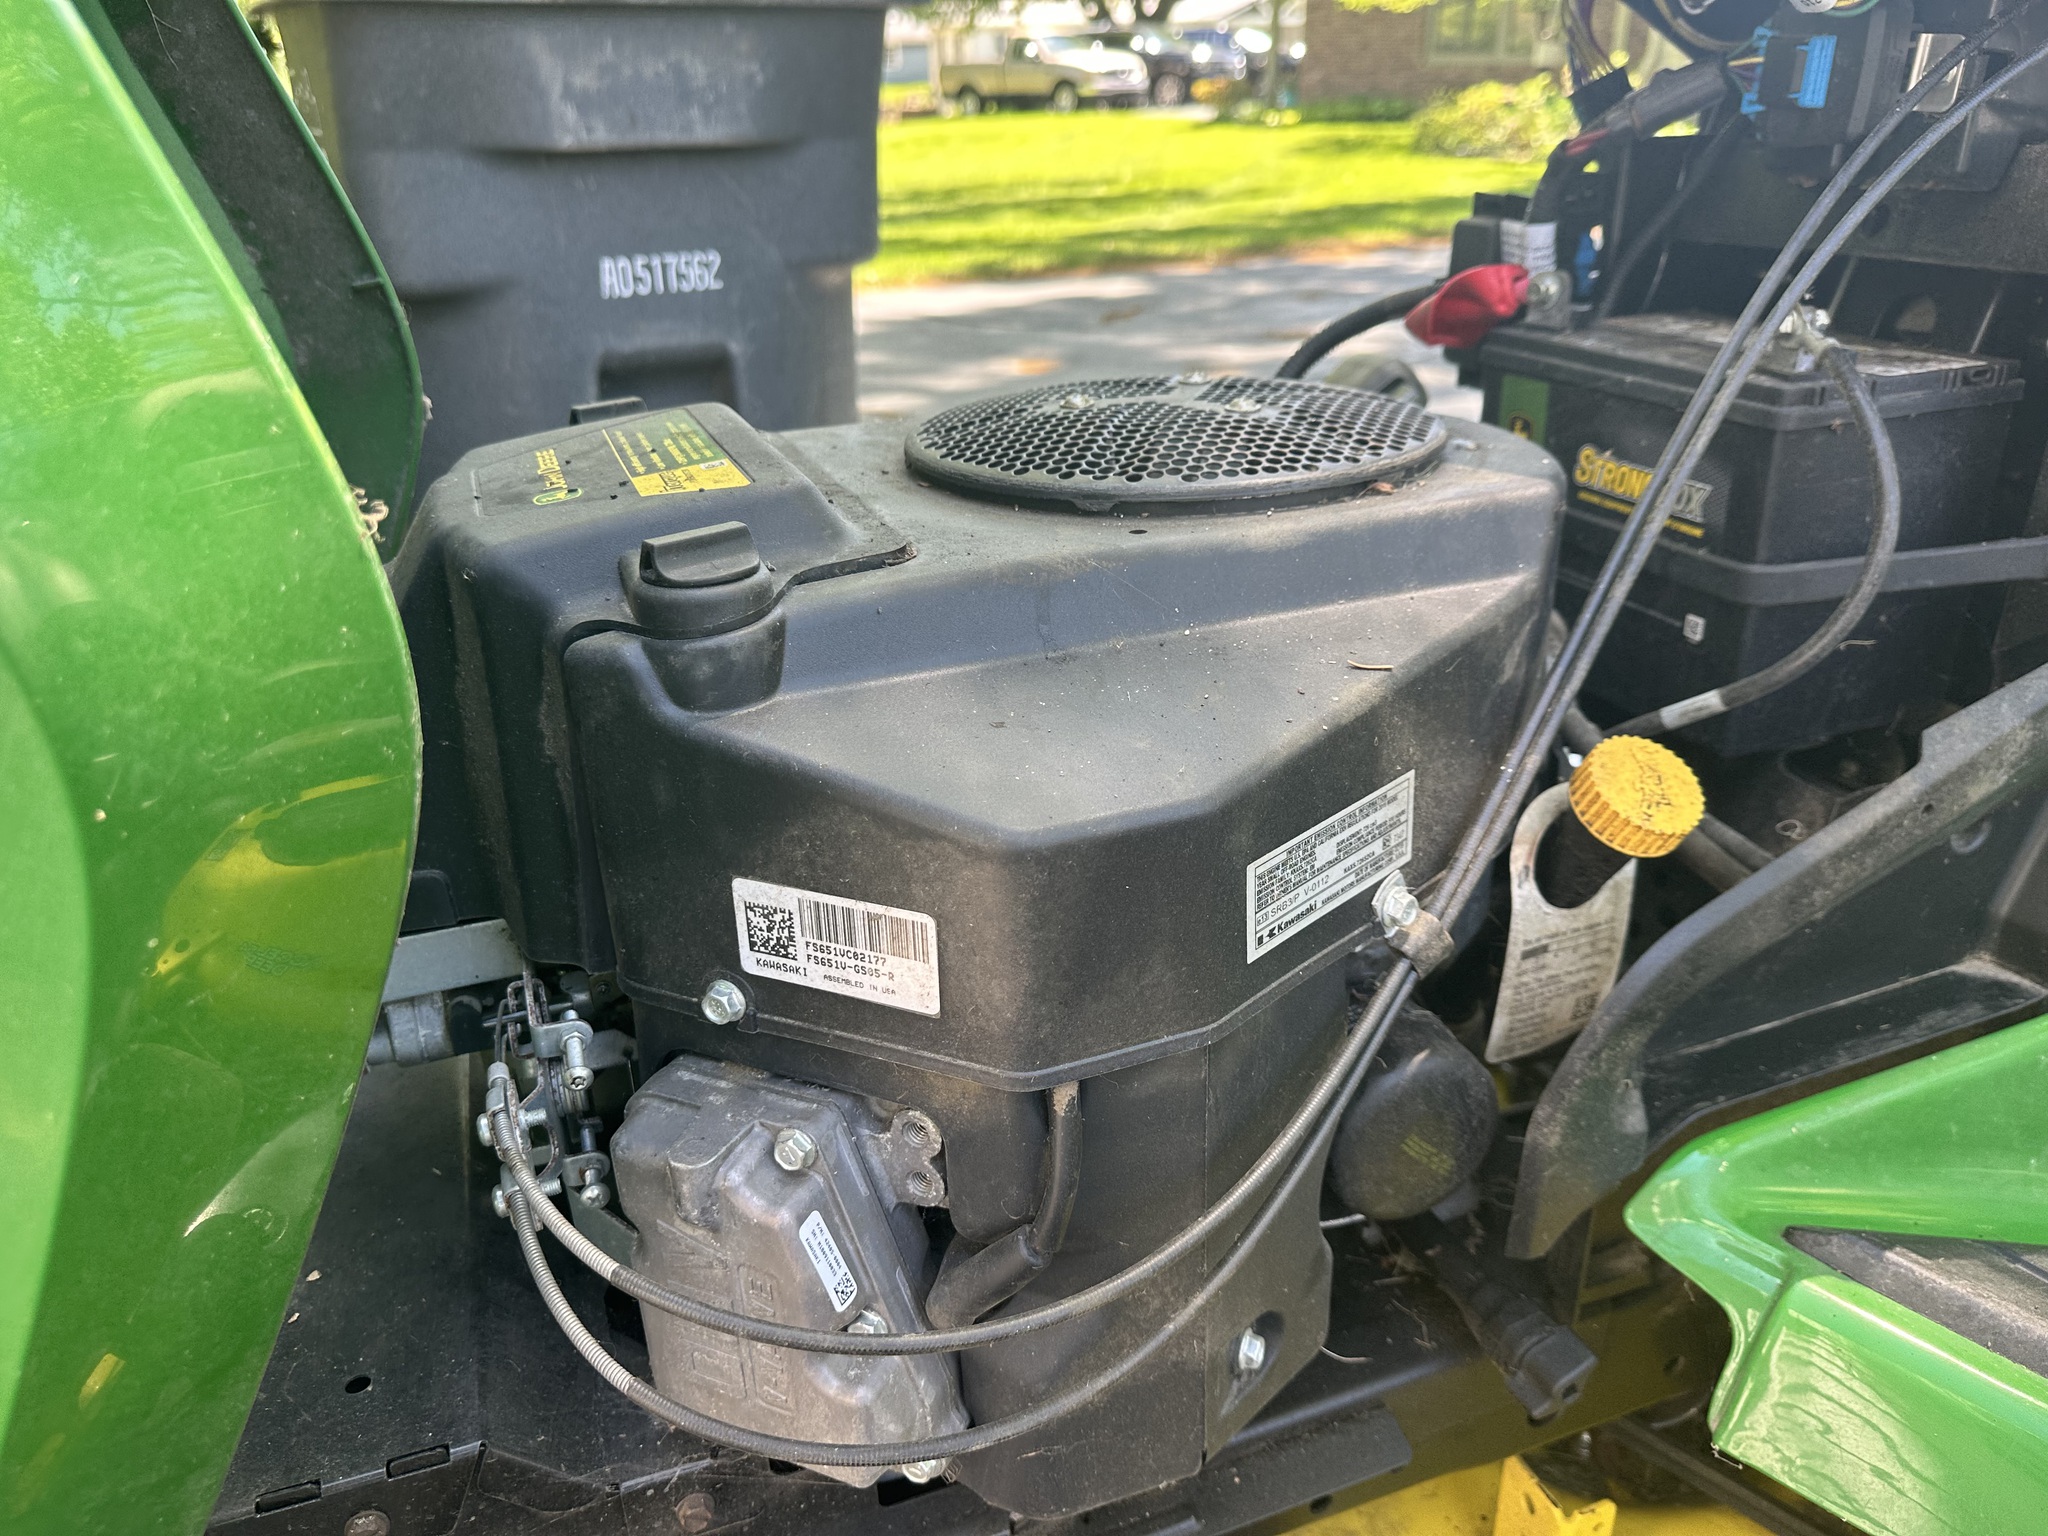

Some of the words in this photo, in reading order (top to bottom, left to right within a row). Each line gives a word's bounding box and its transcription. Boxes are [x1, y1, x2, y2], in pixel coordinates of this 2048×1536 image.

[1304, 874, 1328, 897] V-0112
[1277, 899, 1316, 934] Kawasaki
[805, 941, 887, 966] FS651VC02177
[756, 957, 808, 977] KAWASAKI
[806, 955, 895, 981] FS651V-GS05-R
[823, 974, 865, 989] ASSEMBLED
[869, 984, 878, 993] IN
[805, 1237, 821, 1265] KAWASAKI
